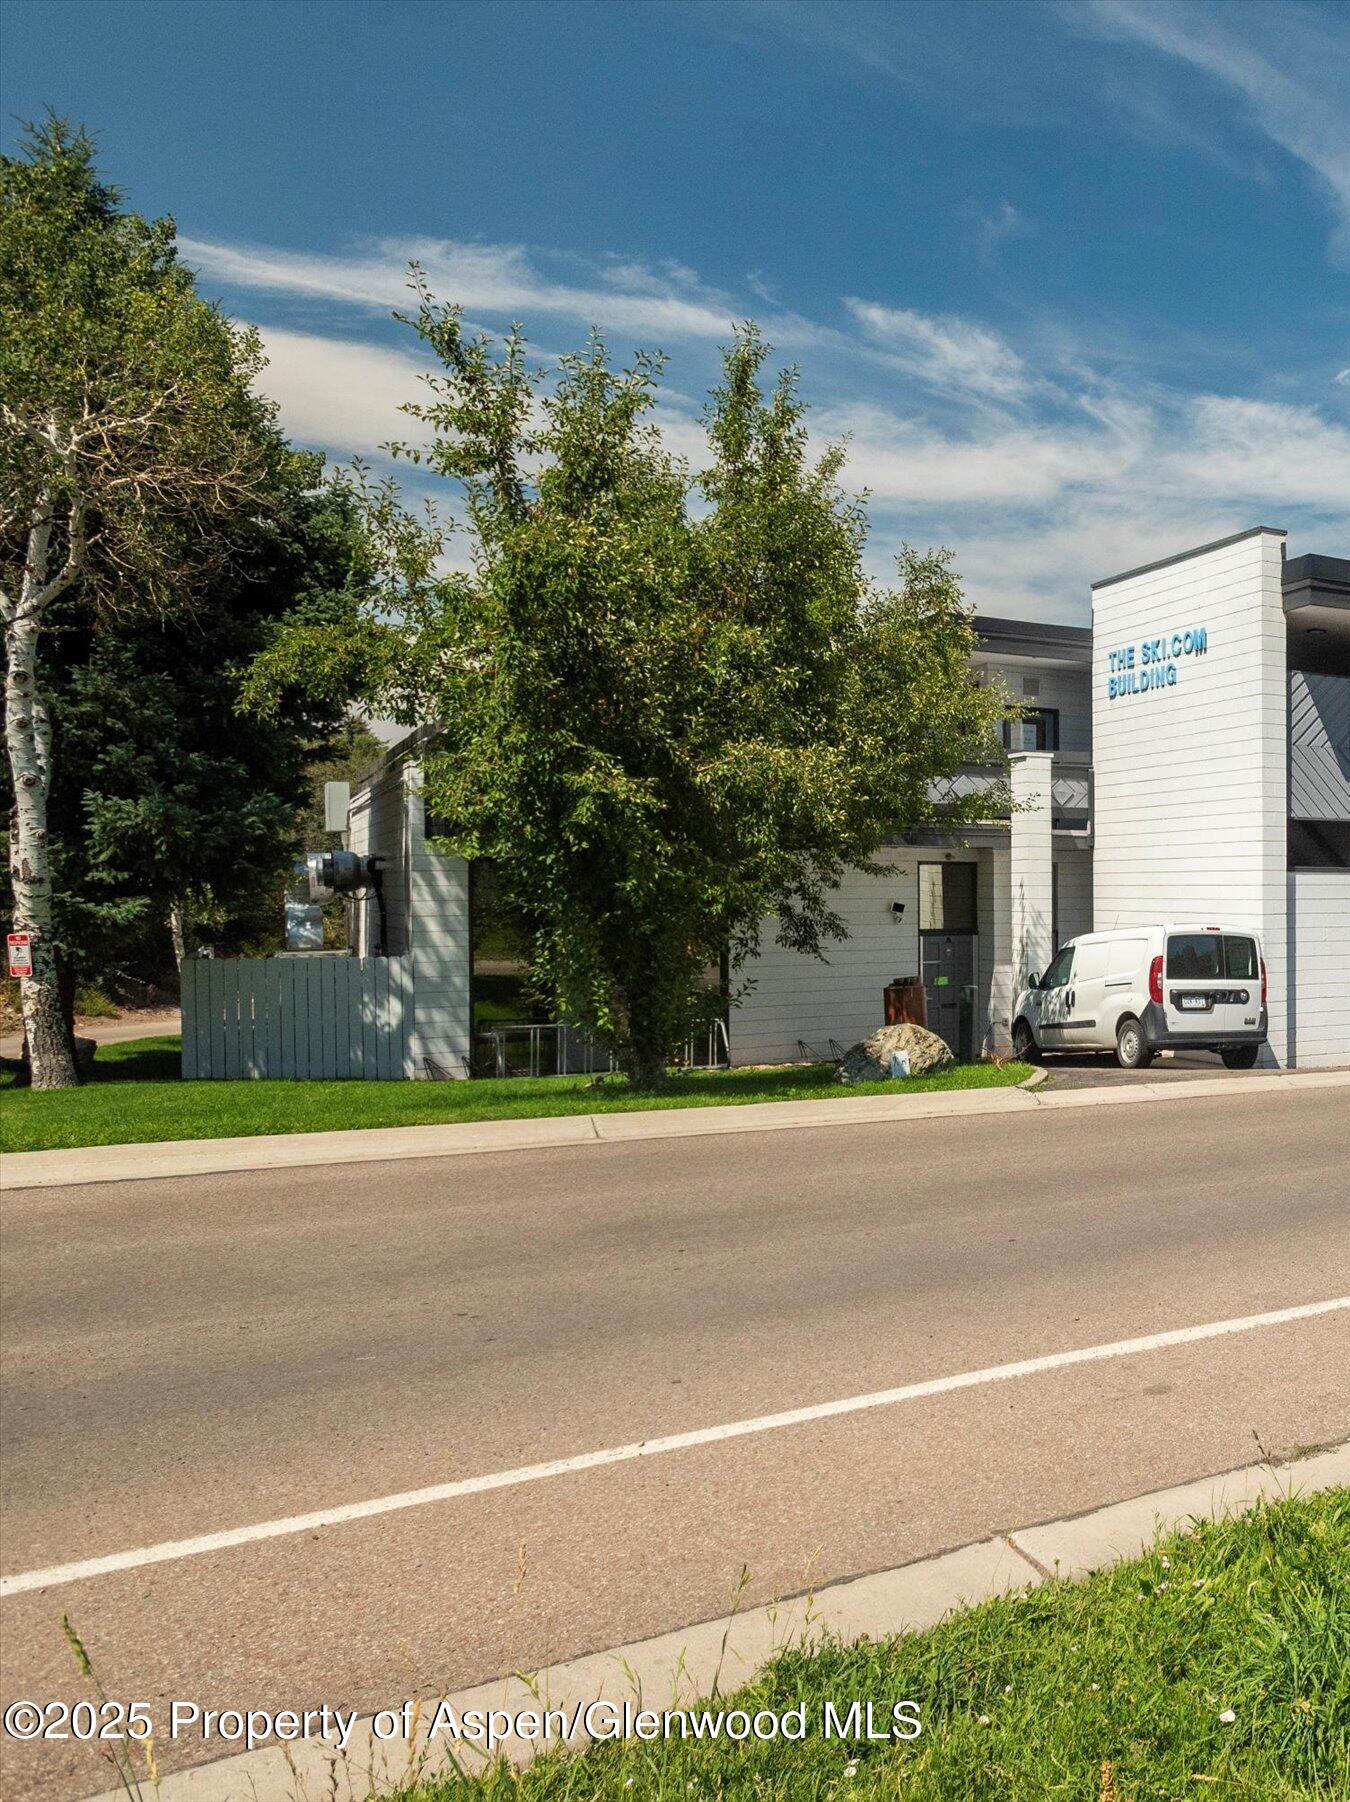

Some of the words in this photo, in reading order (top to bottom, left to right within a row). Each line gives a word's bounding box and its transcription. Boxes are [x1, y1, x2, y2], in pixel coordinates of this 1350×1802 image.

[1108, 646, 1135, 673] THE
[1141, 627, 1207, 665] SKI.COM
[1108, 663, 1177, 700] BUILDING
